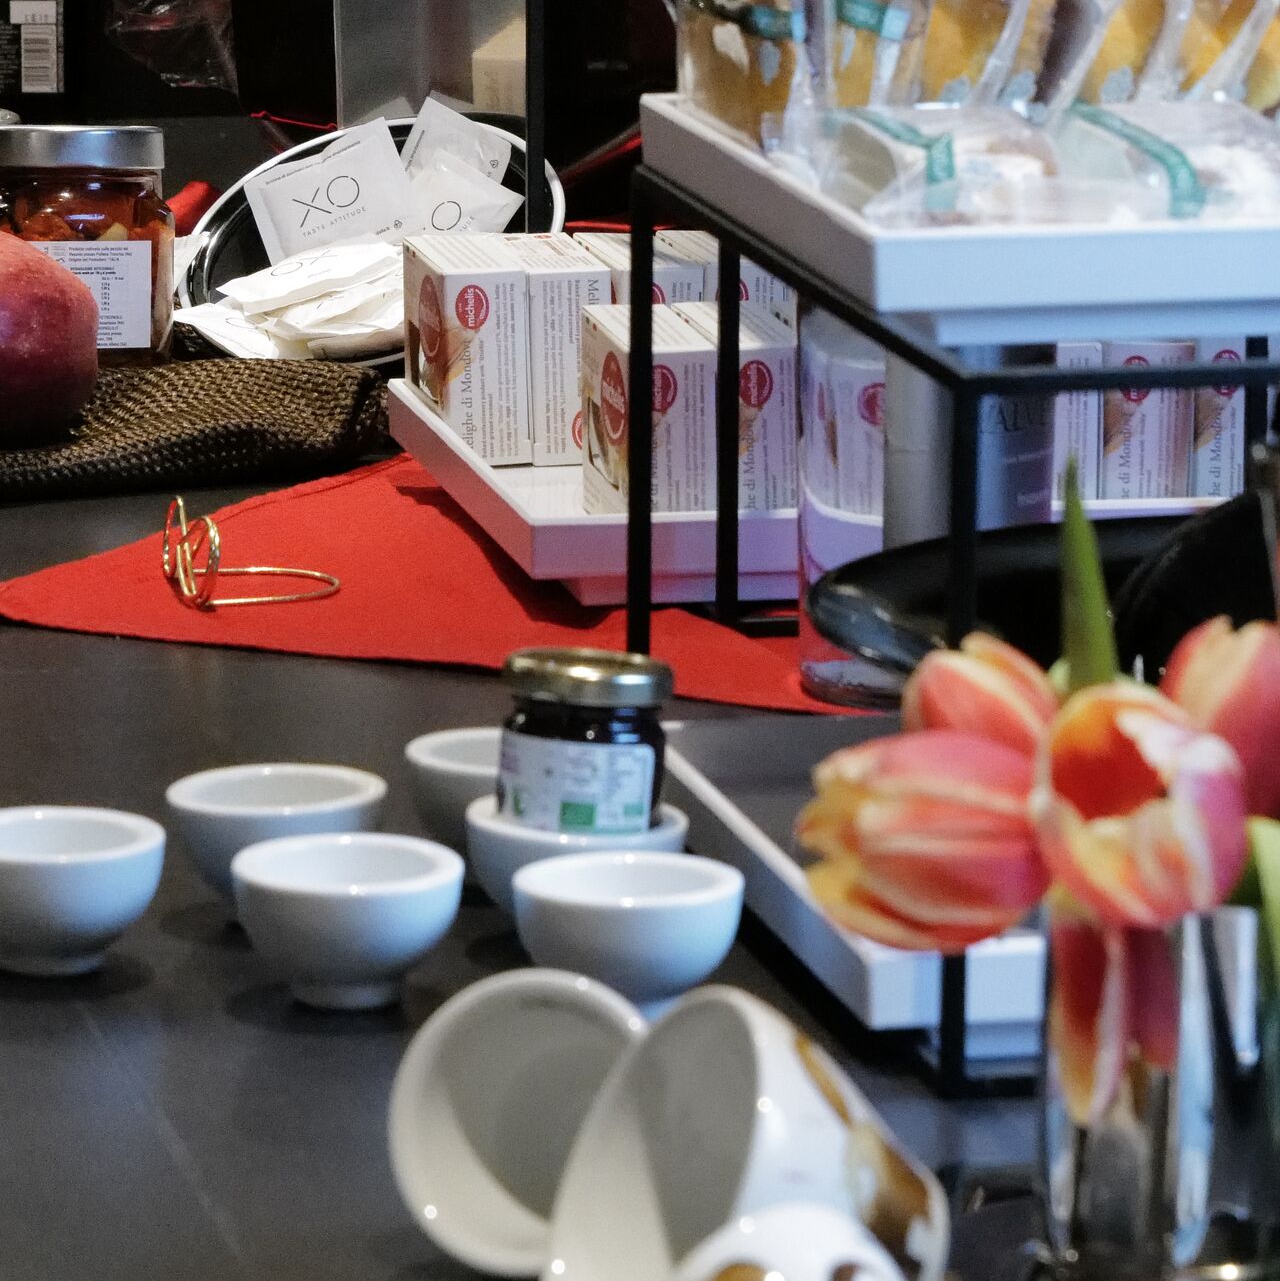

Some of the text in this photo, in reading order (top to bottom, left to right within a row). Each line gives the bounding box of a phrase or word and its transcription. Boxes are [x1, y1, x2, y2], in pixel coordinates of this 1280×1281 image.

[292, 175, 360, 229] XO
[302, 219, 326, 238] TASTE
[588, 279, 599, 306] Meli
[465, 287, 475, 327] michelis
[461, 397, 473, 408] di
[462, 411, 477, 450] elighe
[1118, 472, 1130, 484] di
